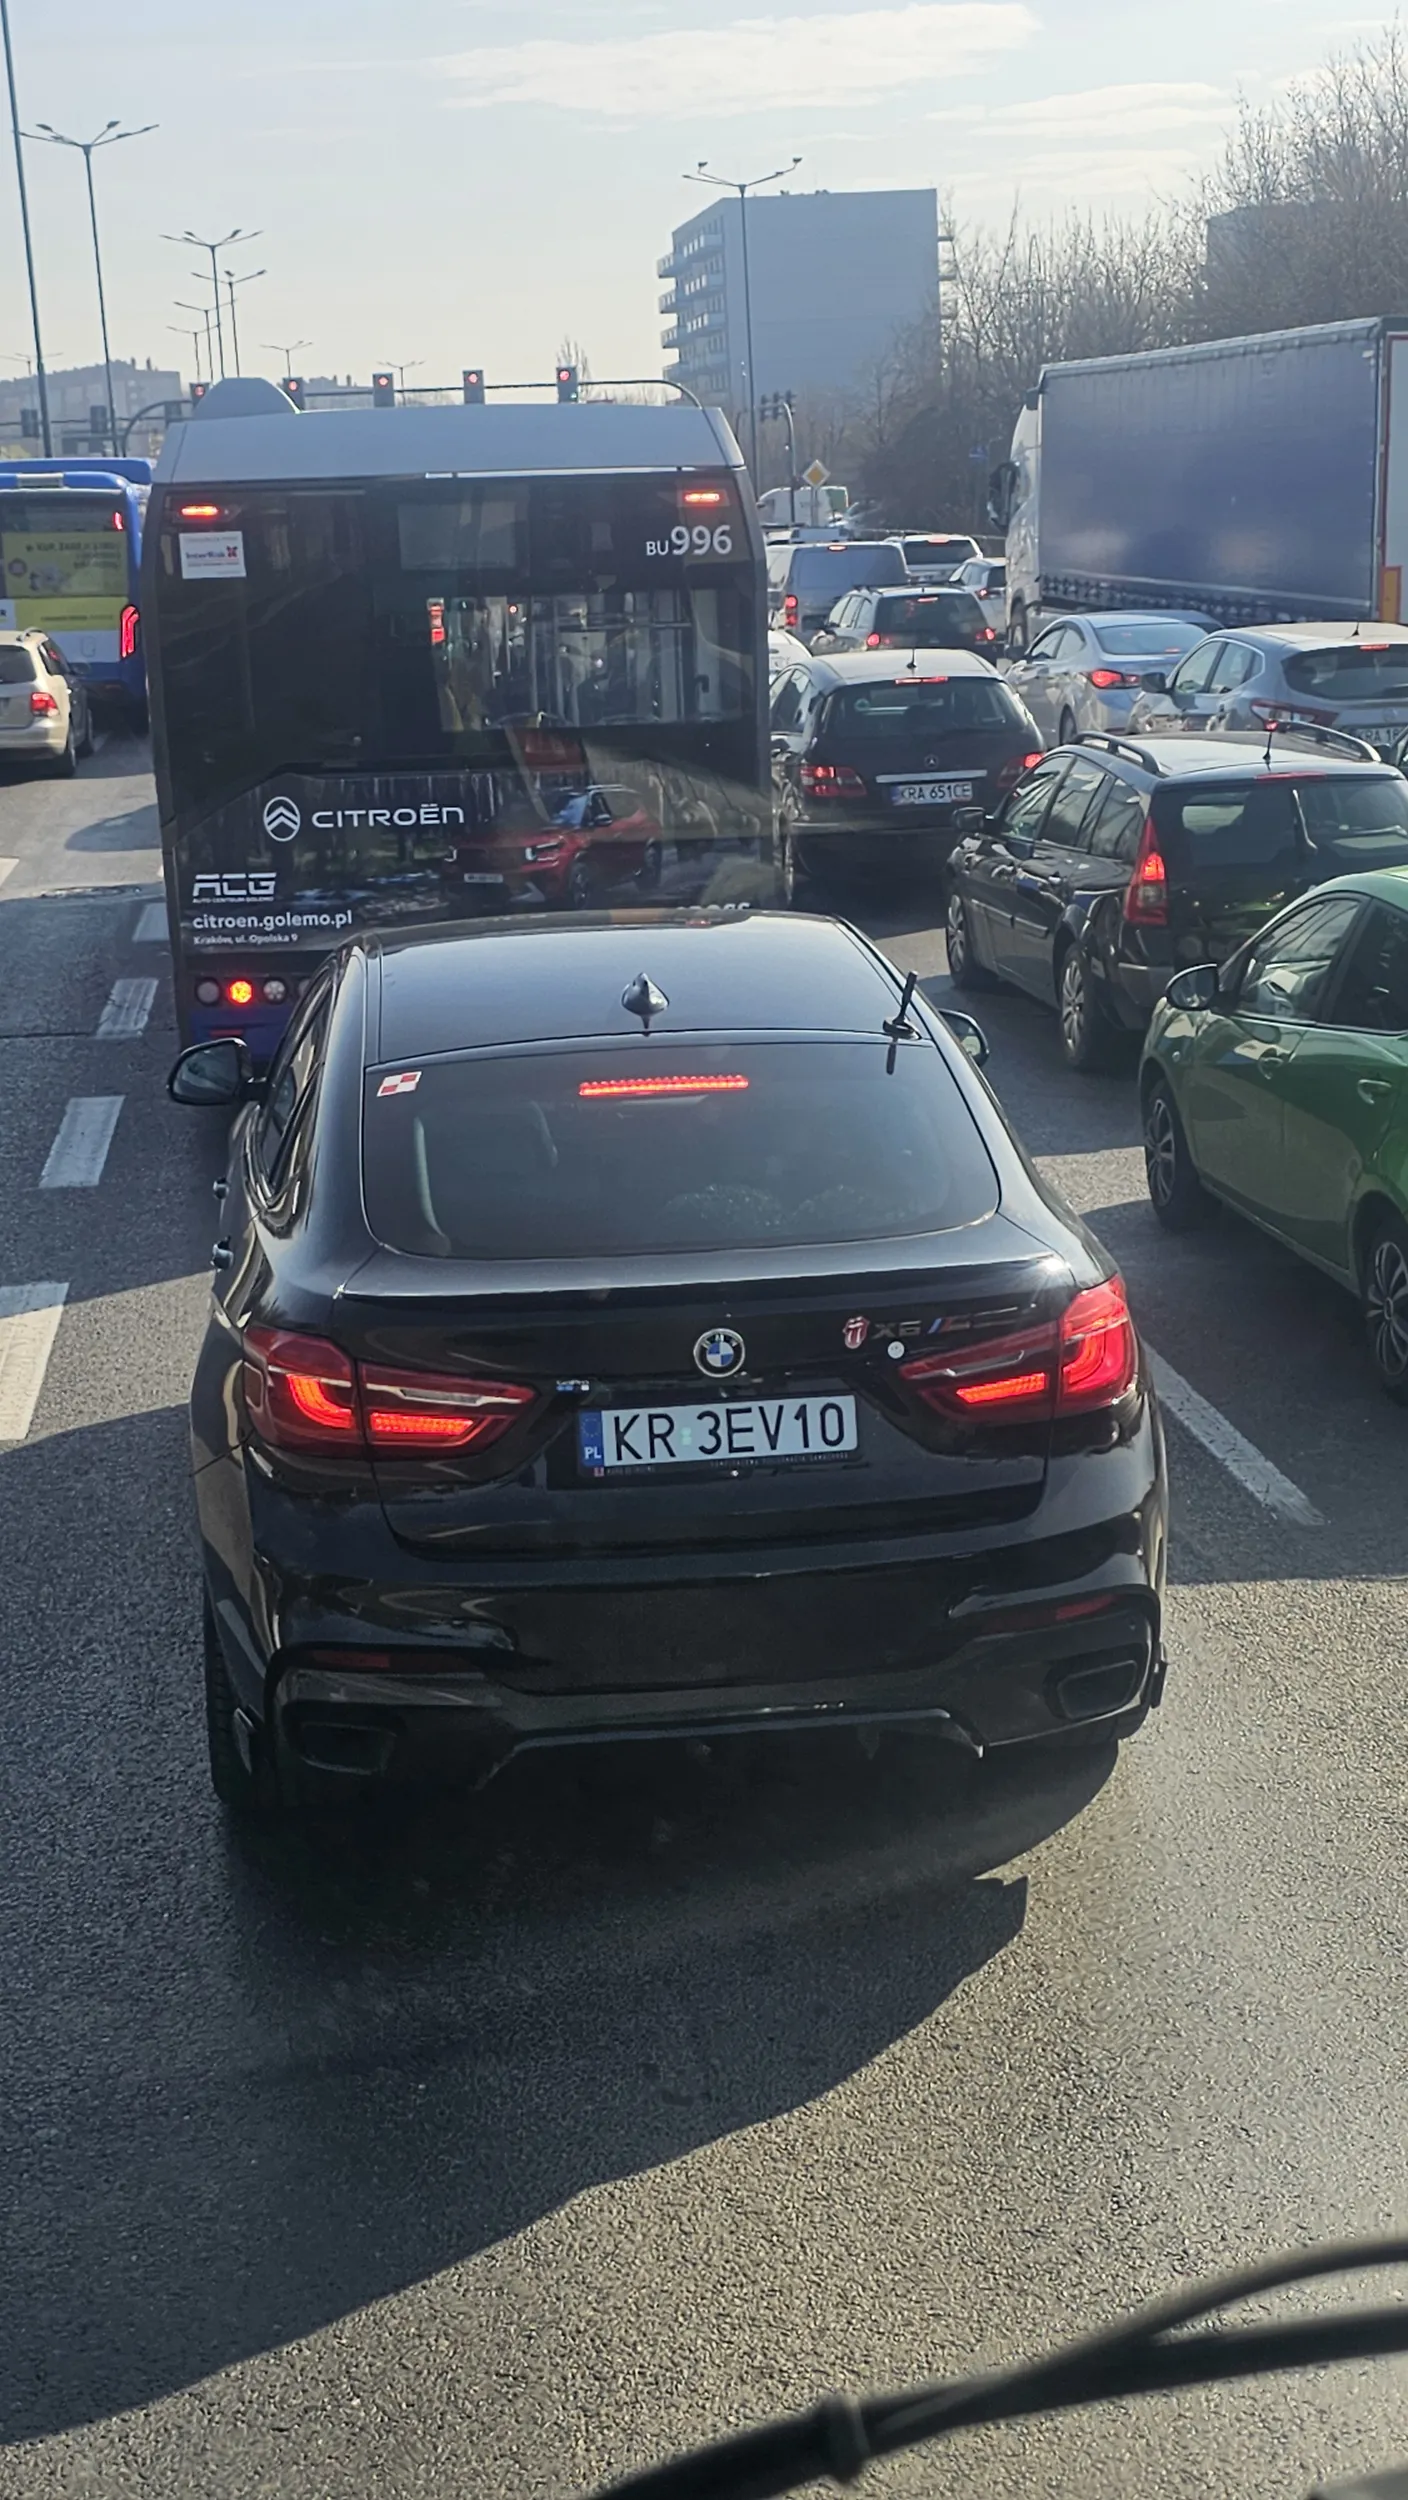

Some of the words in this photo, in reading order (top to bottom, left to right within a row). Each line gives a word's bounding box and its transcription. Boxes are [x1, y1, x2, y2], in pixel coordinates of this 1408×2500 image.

[646, 540, 669, 556] BU
[670, 525, 732, 555] 996
[901, 786, 925, 800] KRA
[930, 783, 971, 799] 651CE
[311, 803, 465, 828] CITROËN
[192, 872, 277, 897] ACG
[193, 909, 353, 932] citroen.golemo.pl
[249, 934, 289, 945] Opolska
[291, 933, 298, 942] 9
[613, 1413, 676, 1461] KR
[696, 1402, 845, 1455] 3EV10
[584, 1446, 602, 1459] PL
